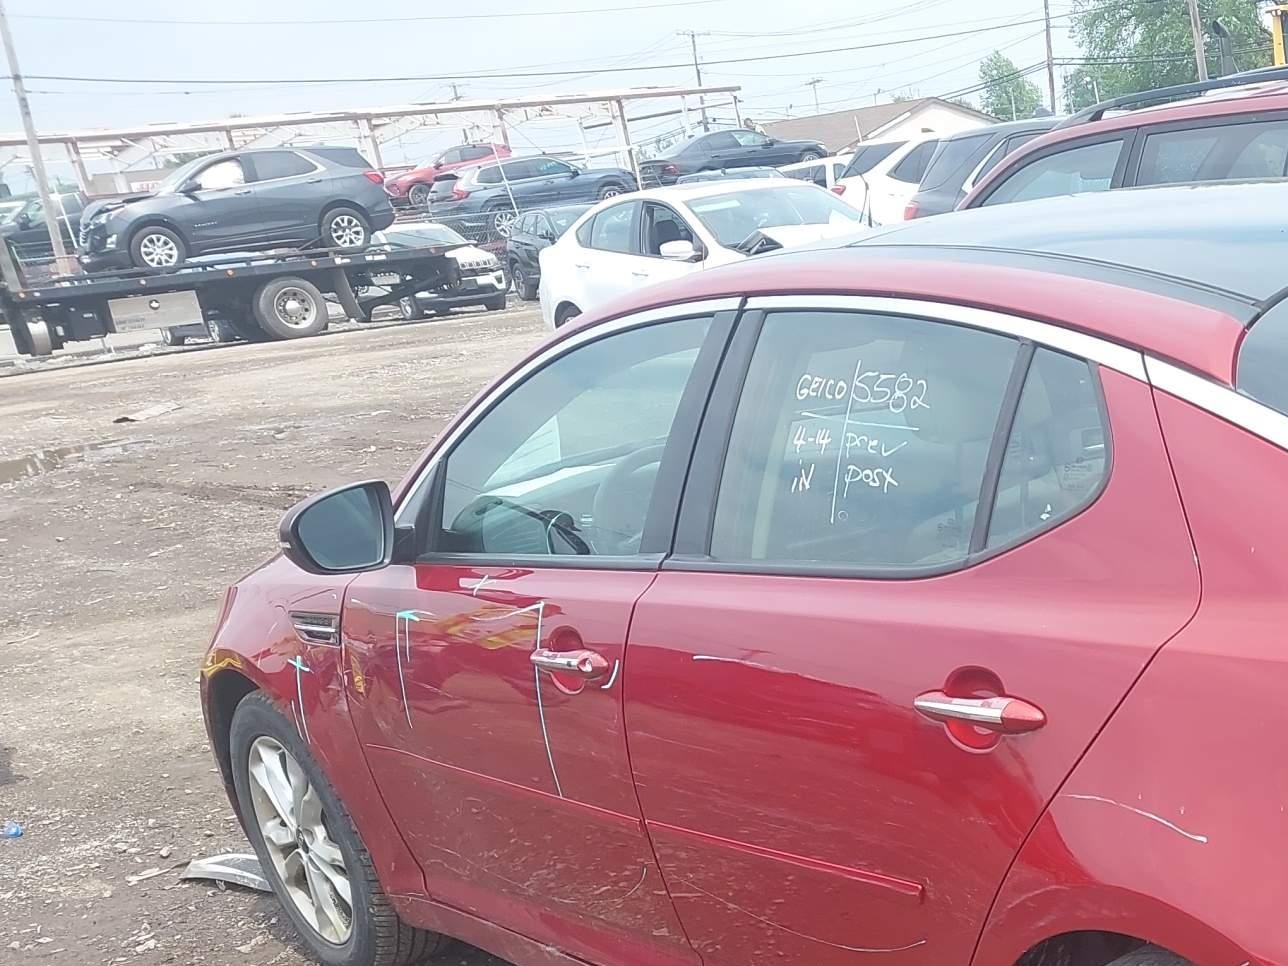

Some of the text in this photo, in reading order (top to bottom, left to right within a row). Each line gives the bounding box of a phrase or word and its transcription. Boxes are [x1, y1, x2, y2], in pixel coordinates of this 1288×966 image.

[795, 371, 931, 414] GEICO 5582
[792, 425, 832, 455] 4-14
